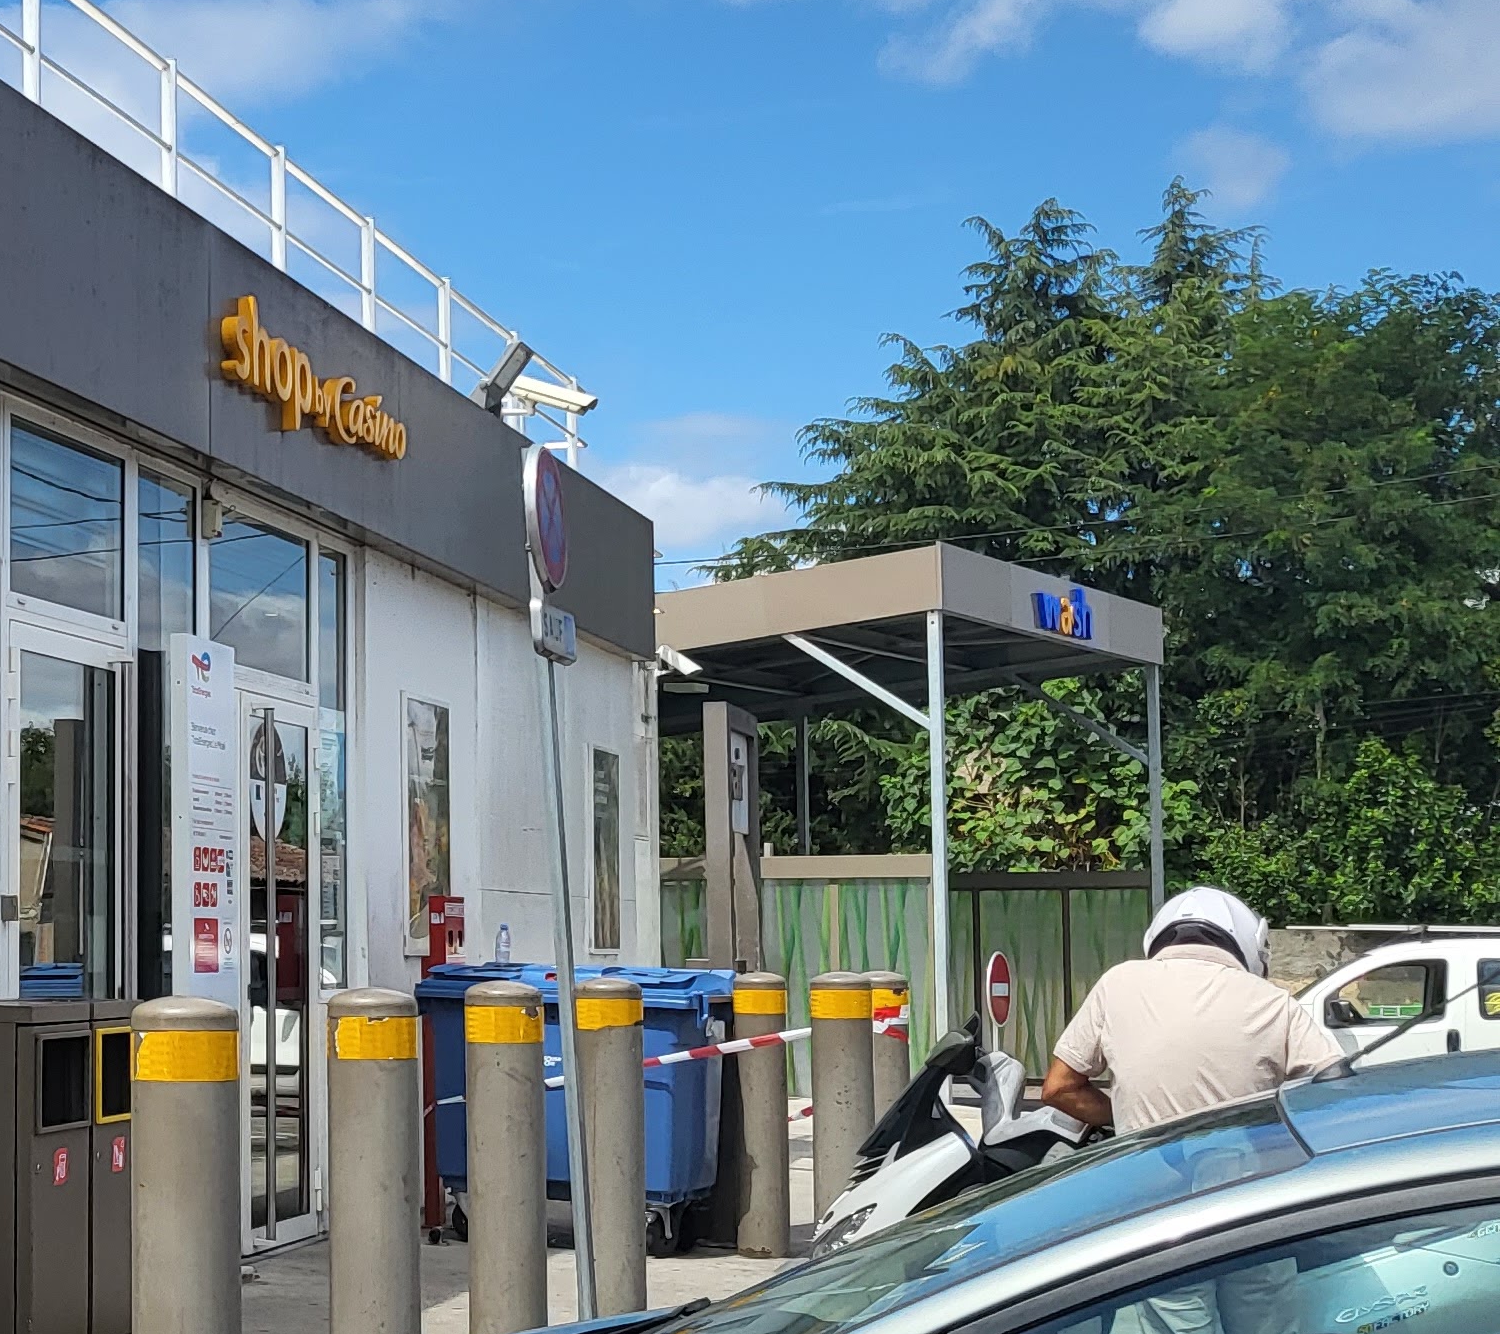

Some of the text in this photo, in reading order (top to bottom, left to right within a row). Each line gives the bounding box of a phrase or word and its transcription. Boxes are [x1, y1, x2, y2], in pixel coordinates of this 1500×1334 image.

[221, 295, 406, 459] shop by Casino
[1031, 589, 1092, 640] wash
